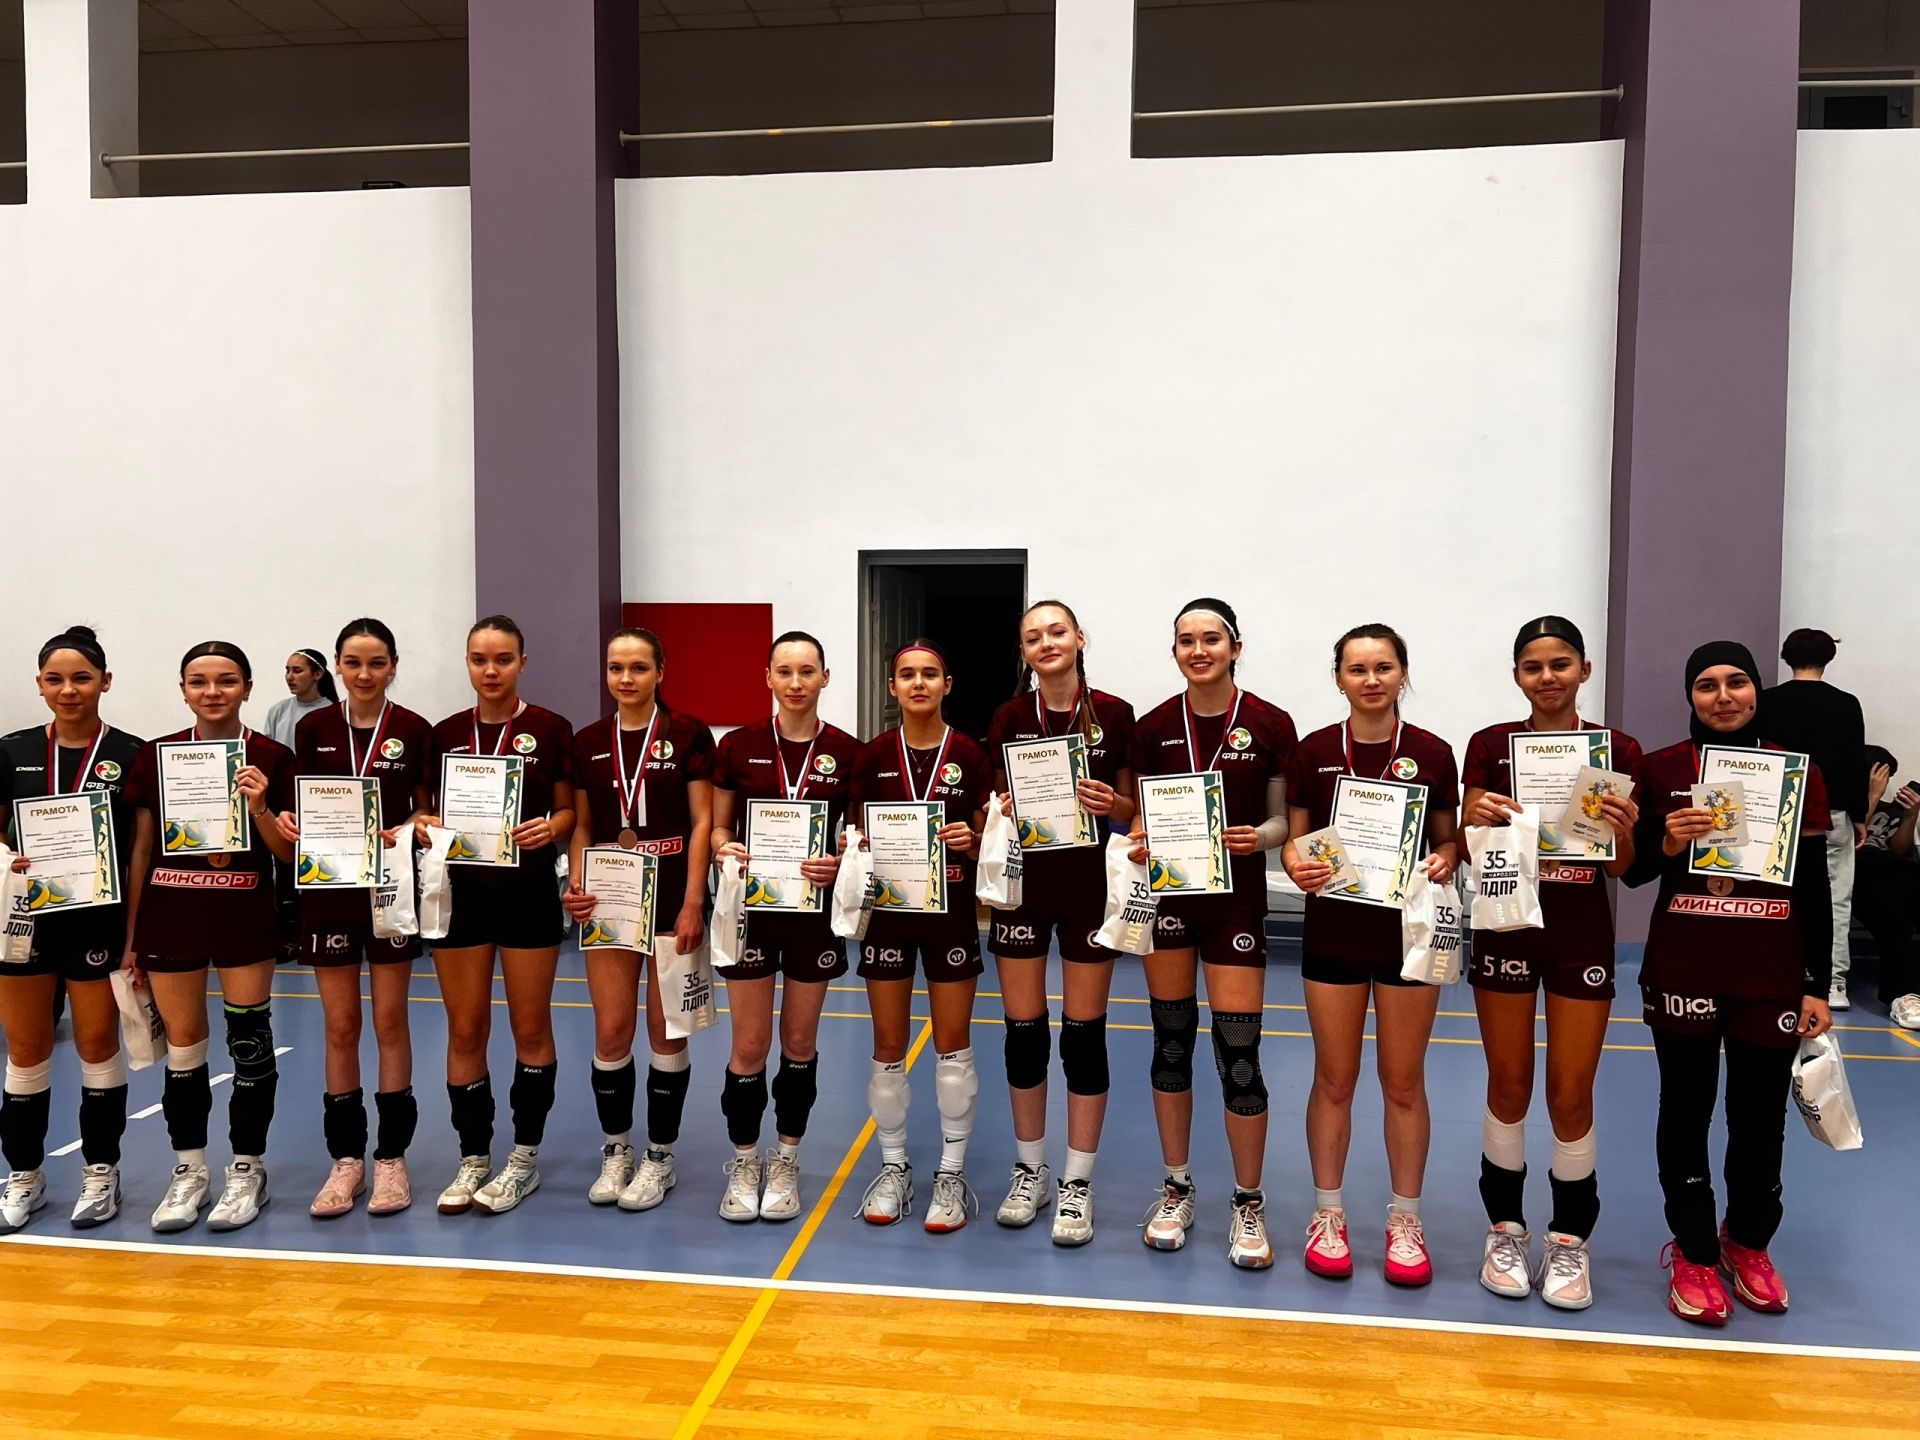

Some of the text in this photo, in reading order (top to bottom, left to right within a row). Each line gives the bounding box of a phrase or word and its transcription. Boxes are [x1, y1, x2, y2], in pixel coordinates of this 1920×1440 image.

[171, 752, 216, 760] ГРАМОТА
[1017, 749, 1059, 760] ГРАМОТА
[1525, 745, 1577, 754] ГРАМОТА
[455, 765, 496, 774] ГРАМОТА
[1717, 759, 1770, 772] ГРАМОТА
[309, 787, 352, 795] ГРАМОТА
[1152, 786, 1194, 796] ГРАМОТА
[1349, 789, 1395, 802] ГРАМОТА
[30, 805, 79, 816] ГРАМОТА
[760, 810, 800, 818] ГРАМОТА
[877, 813, 918, 821] ГРАМОТА
[1008, 839, 1020, 856] 35
[595, 858, 635, 867] ГРАМОТА
[1484, 850, 1506, 869] 35
[154, 871, 256, 885] МИНСПОРТ
[1130, 881, 1149, 899] 35
[1671, 898, 1788, 915] МИНСПОРТ
[1120, 908, 1154, 924] ЛДПР
[1436, 906, 1455, 924] 35
[996, 923, 1008, 943] 12
[312, 934, 317, 953] 1
[744, 948, 765, 962] CL
[865, 946, 875, 964] 9
[1483, 955, 1495, 976] 5
[684, 971, 700, 989] 35
[681, 992, 709, 1012] ЛДПР
[1662, 993, 1684, 1017] 10
